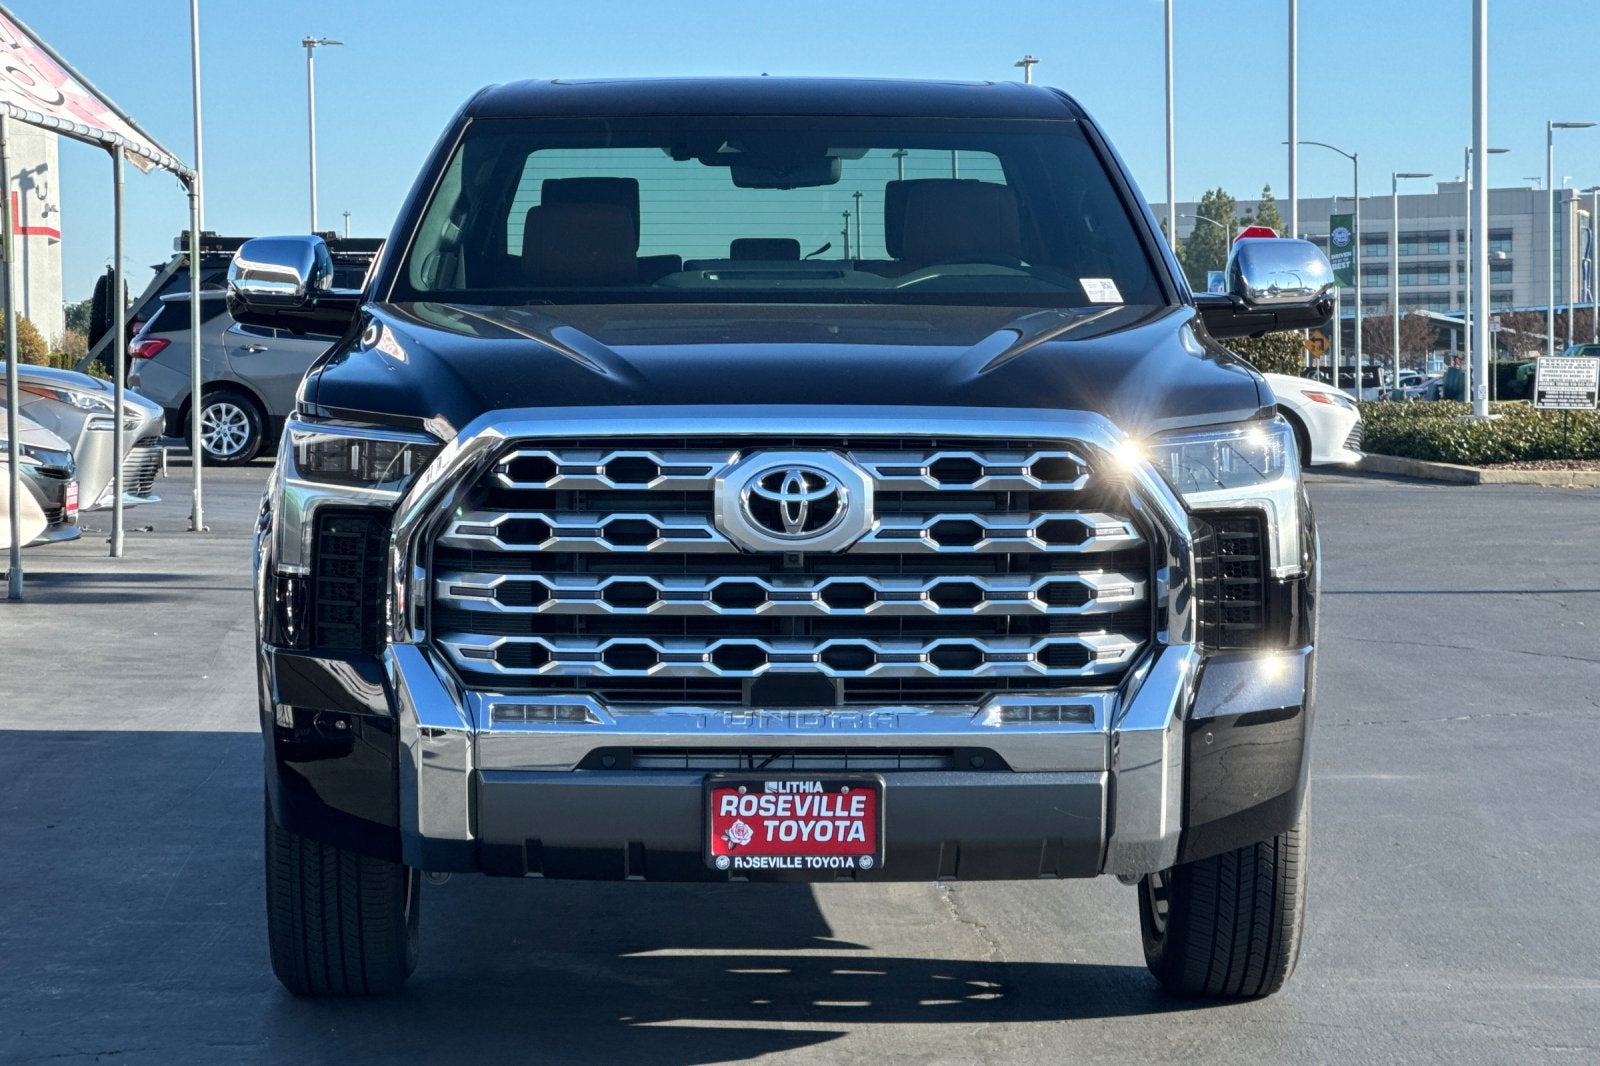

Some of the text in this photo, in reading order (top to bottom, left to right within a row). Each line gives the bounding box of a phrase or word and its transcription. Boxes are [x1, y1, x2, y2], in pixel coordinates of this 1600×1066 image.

[687, 711, 899, 728] TUNDRA
[778, 781, 823, 793] LITHIA
[719, 795, 867, 817] ROSEVILLE
[763, 820, 866, 842] TOYOTA
[734, 856, 854, 868] ROSEVILLE TOYOTA
